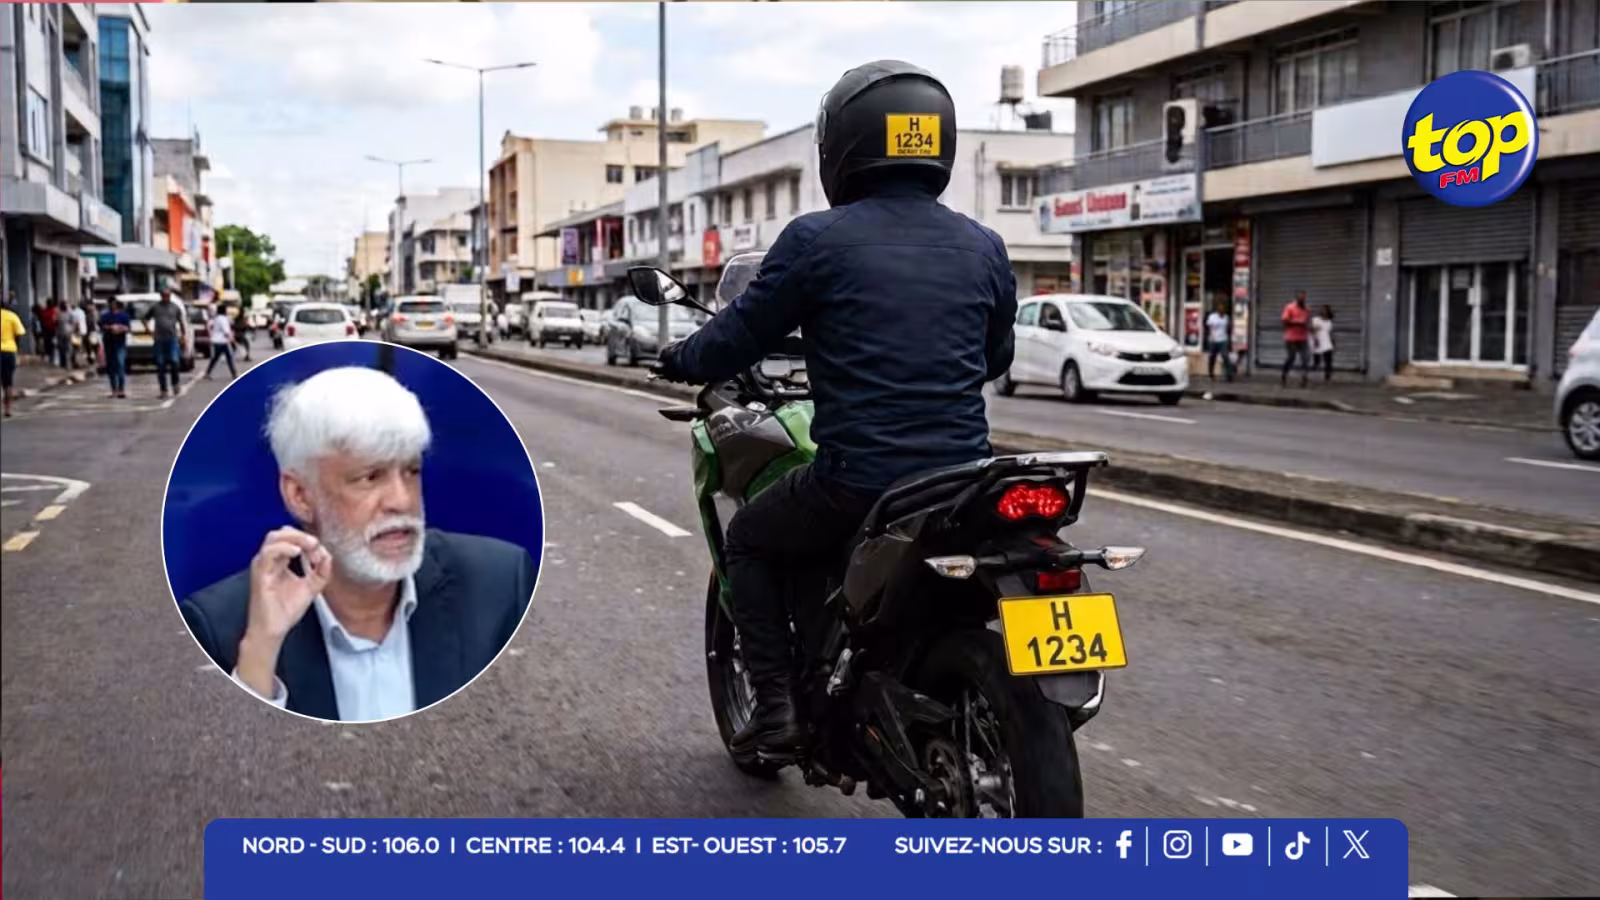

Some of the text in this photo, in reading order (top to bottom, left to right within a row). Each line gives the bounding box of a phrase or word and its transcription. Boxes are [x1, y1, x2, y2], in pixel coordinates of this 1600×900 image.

[909, 117, 920, 132] H
[895, 132, 933, 148] 1234
[1050, 601, 1073, 631] H
[1027, 632, 1107, 667] 1234
